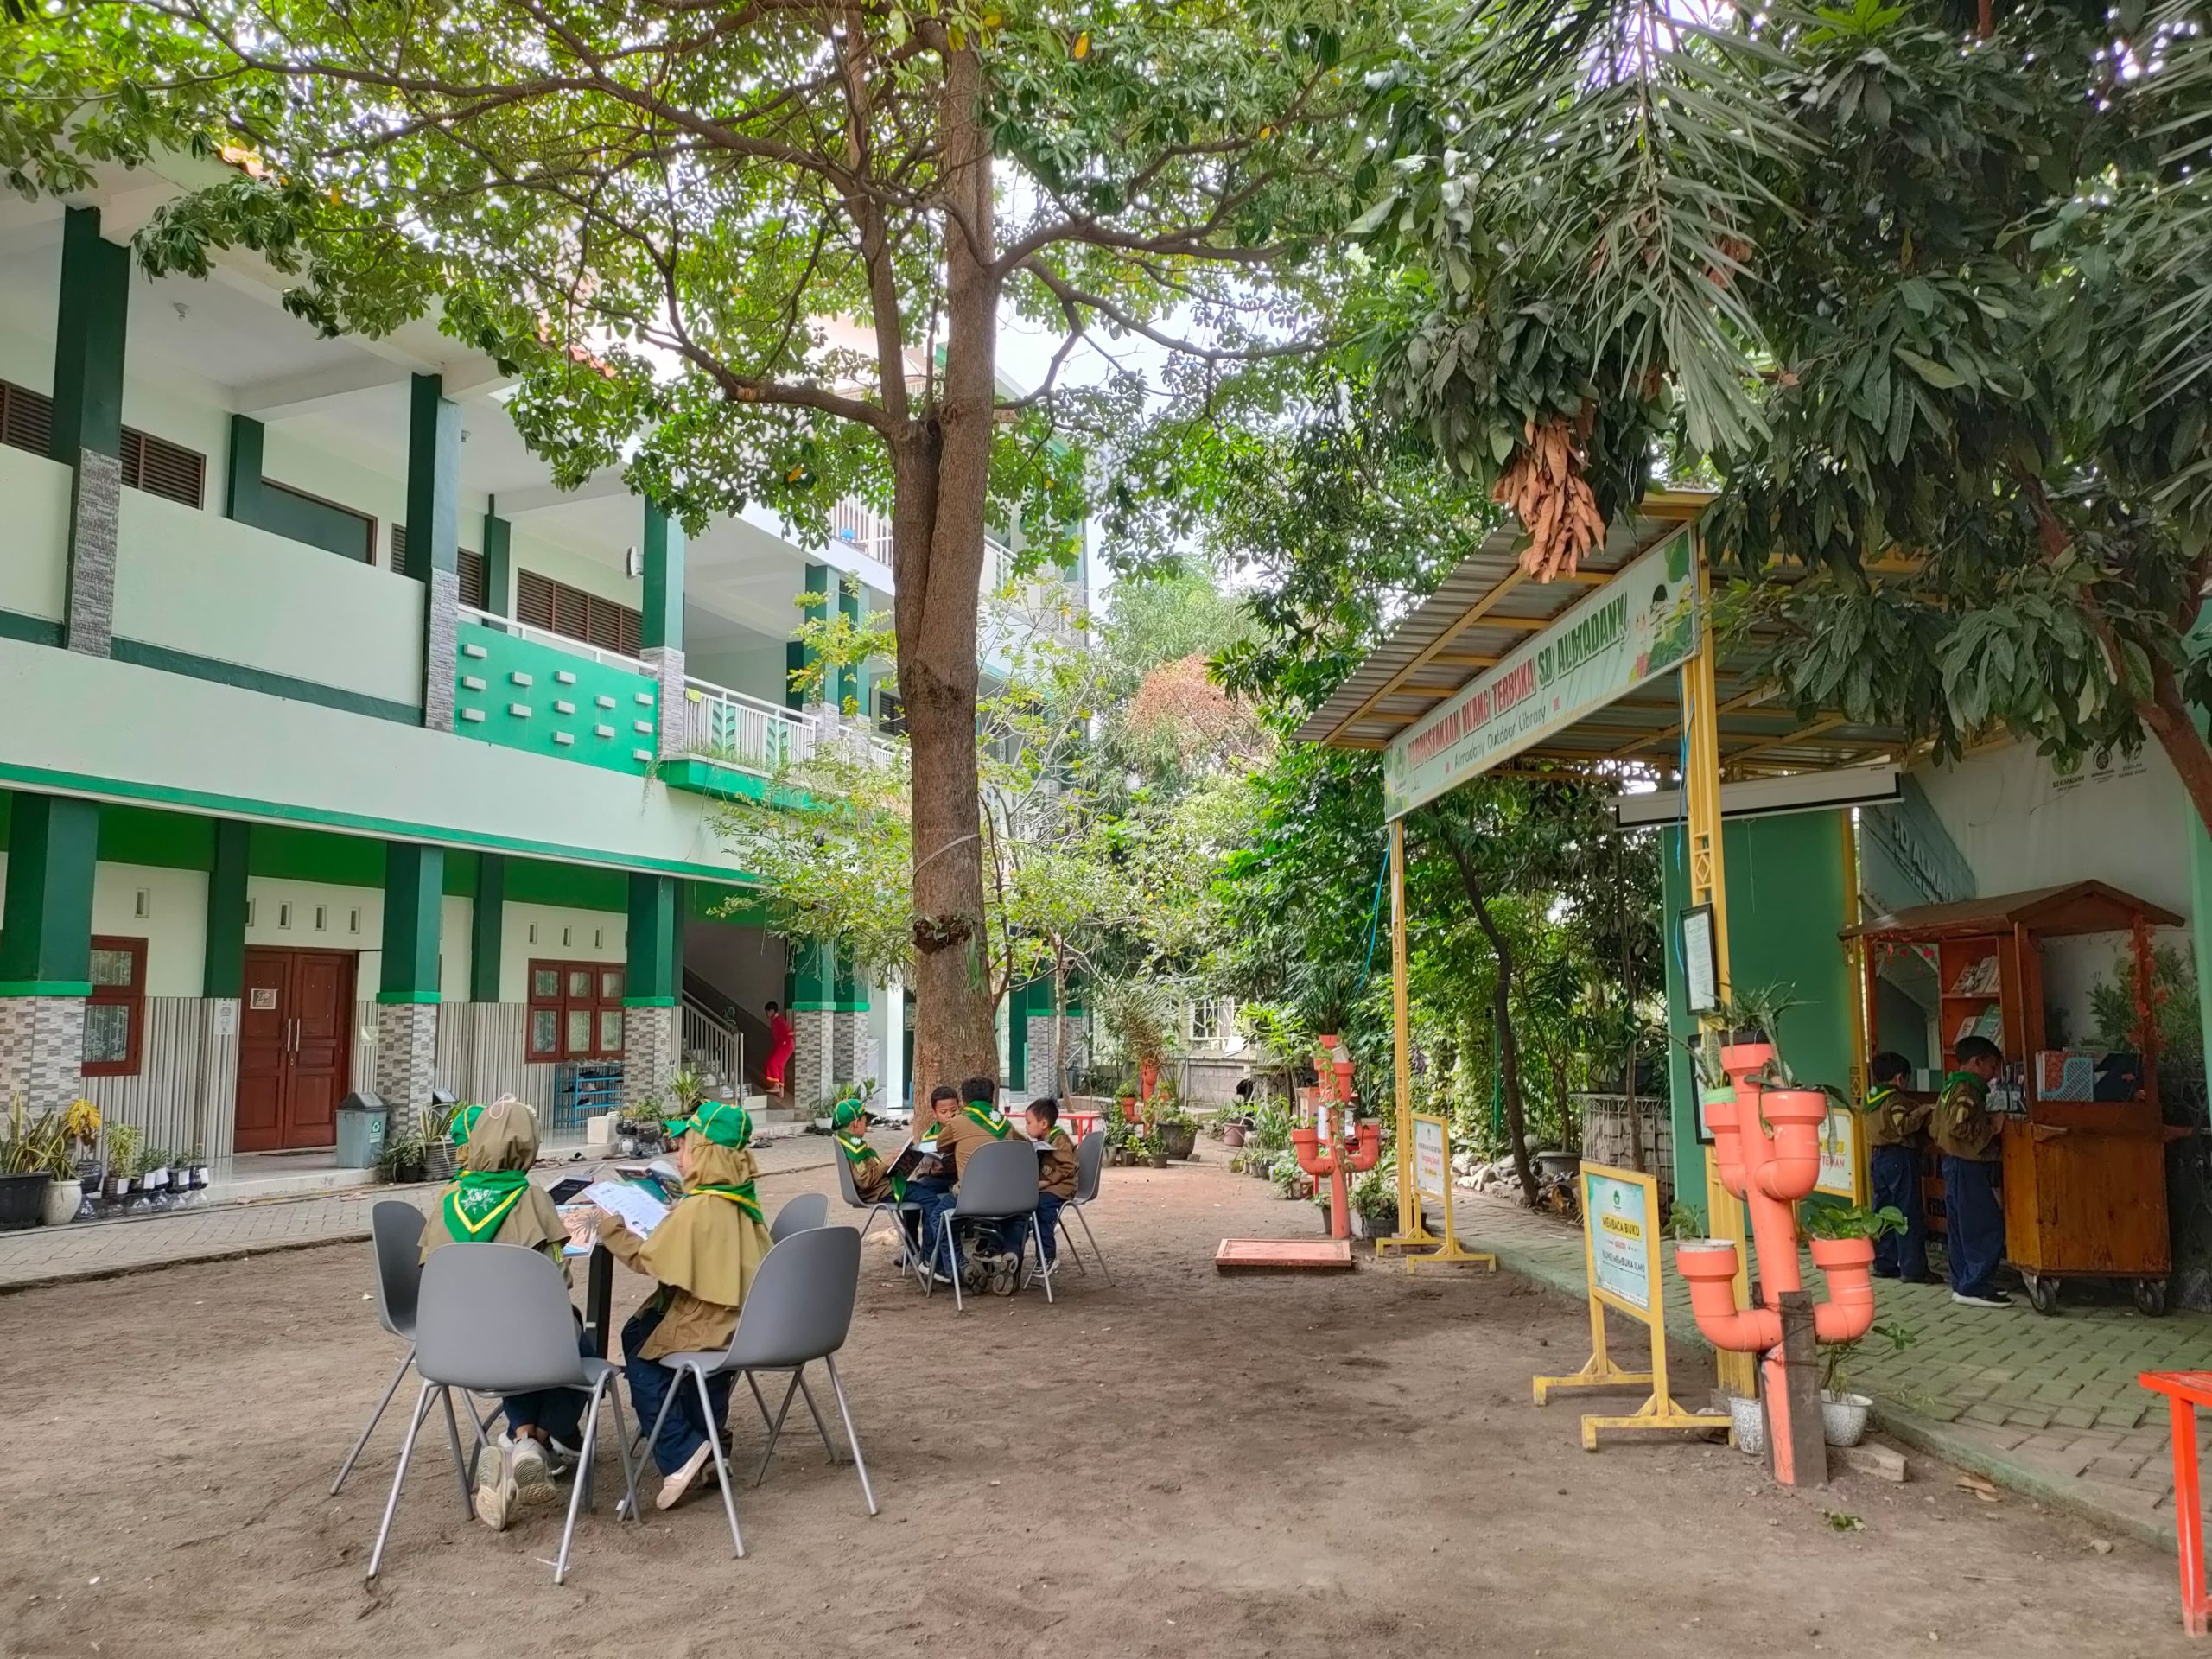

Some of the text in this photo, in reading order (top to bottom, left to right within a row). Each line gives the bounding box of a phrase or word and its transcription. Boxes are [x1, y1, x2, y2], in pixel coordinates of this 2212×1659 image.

[1408, 593, 1625, 770] PERPUSTAKAAN RUANG TERBUKA SD ALMADANY
[1454, 705, 1546, 769] Almadany Outdoor Library
[1602, 1216, 1640, 1236] MEMBACA BUKU
[1613, 1255, 1634, 1268] MEMBUKA
[1634, 1262, 1645, 1273] ILMU
